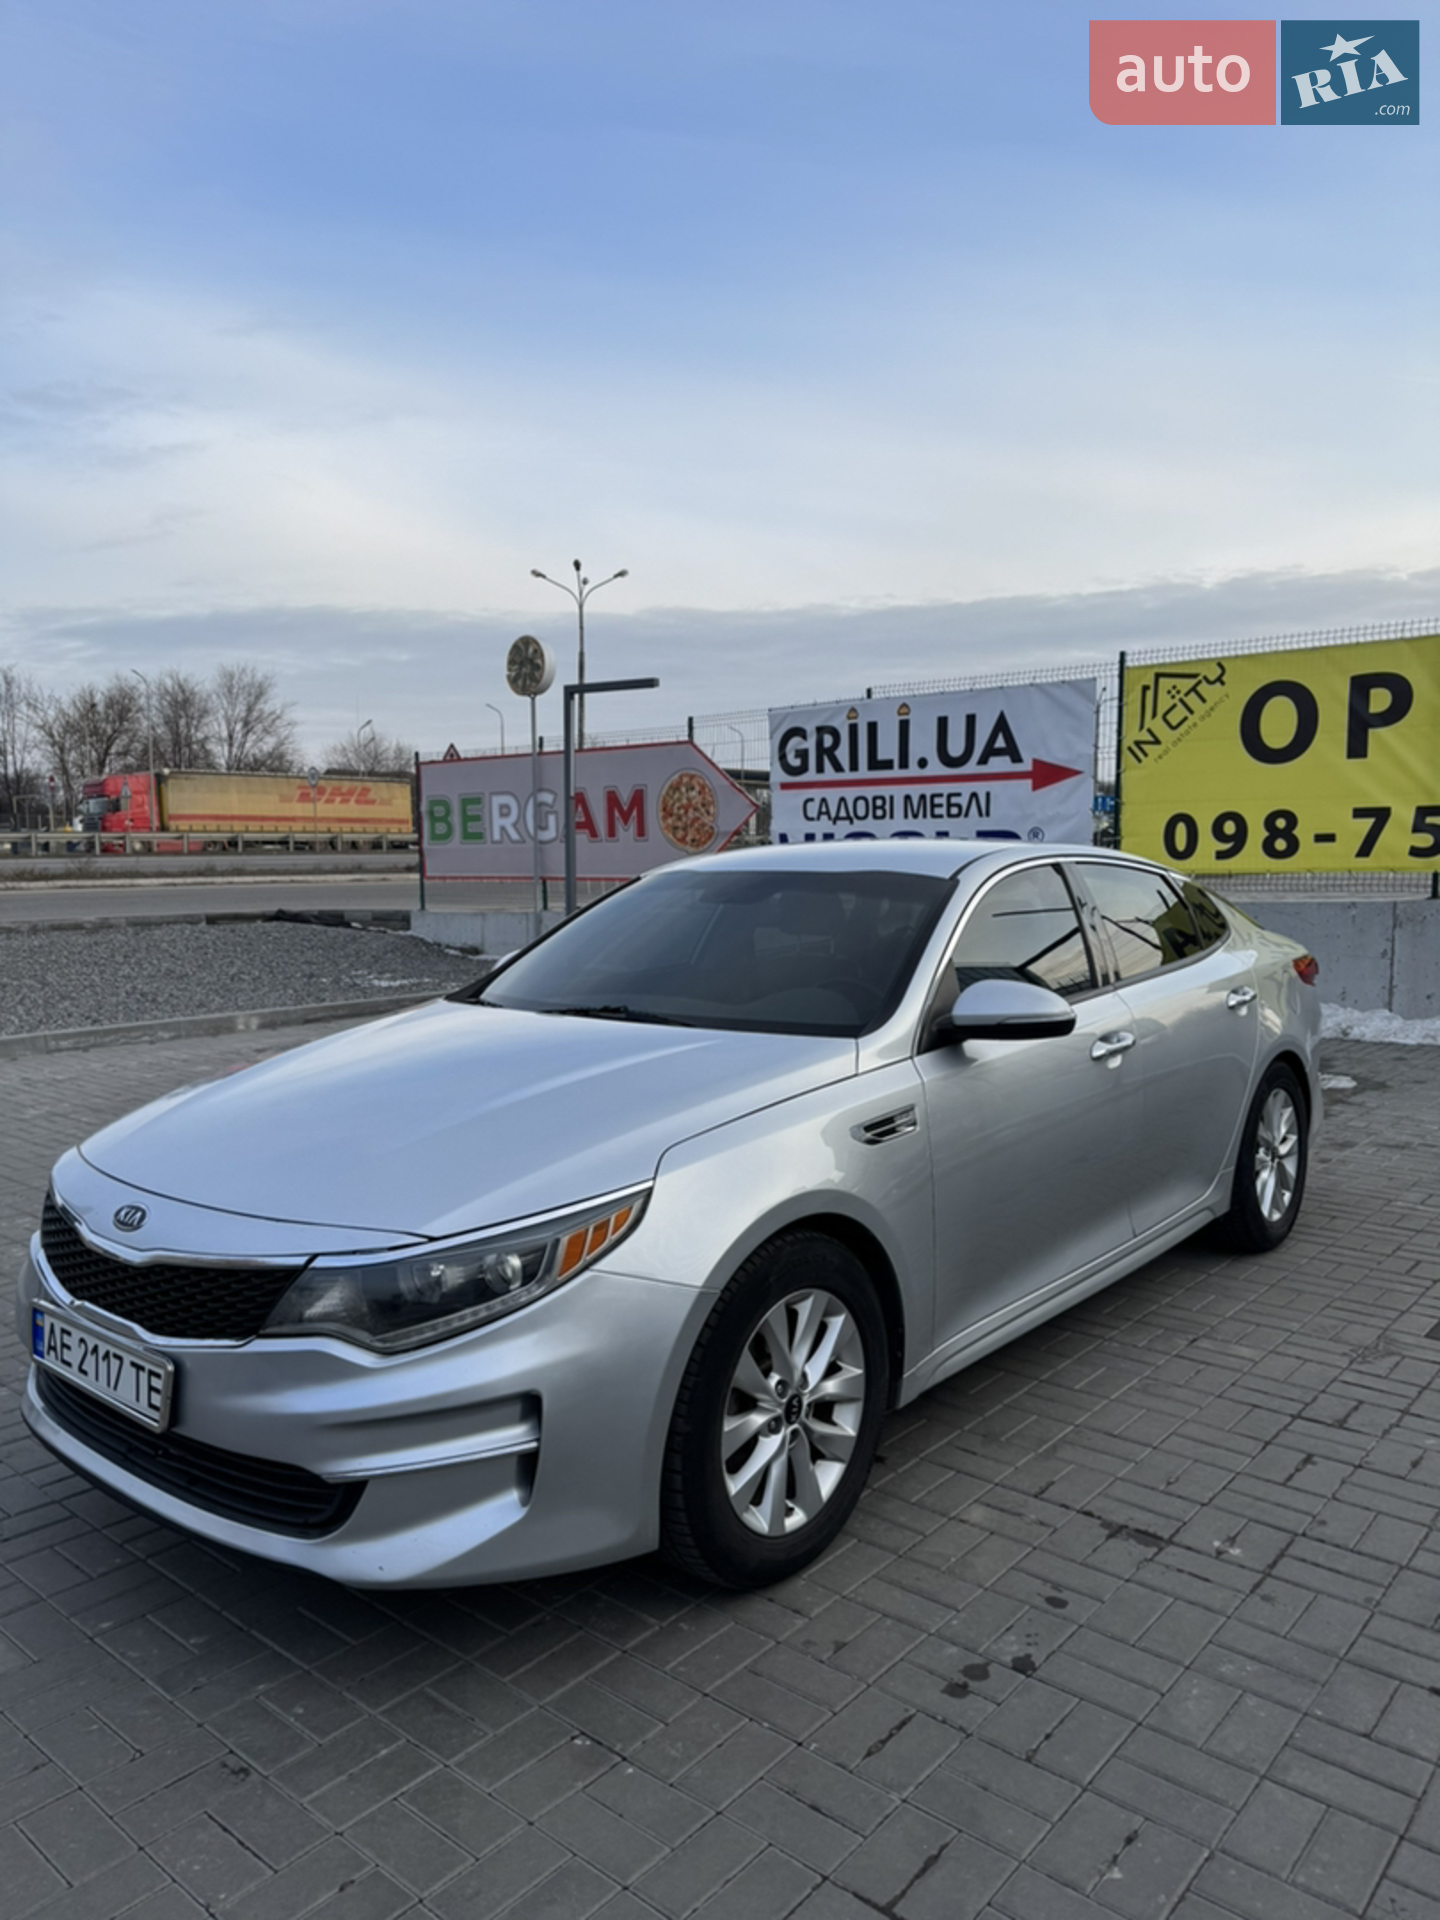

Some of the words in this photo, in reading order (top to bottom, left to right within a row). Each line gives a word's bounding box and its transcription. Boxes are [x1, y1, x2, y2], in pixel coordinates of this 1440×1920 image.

[1127, 727, 1162, 764] IN
[1162, 661, 1226, 731] CITY
[296, 785, 378, 806] DHL
[802, 794, 895, 825] САДОВІ
[903, 791, 991, 820] МЕБЛІ
[1163, 805, 1440, 861] 098-75
[116, 1207, 143, 1226] KIA
[46, 1322, 72, 1368] AE
[78, 1337, 124, 1391] 2117
[130, 1361, 162, 1412] TE
